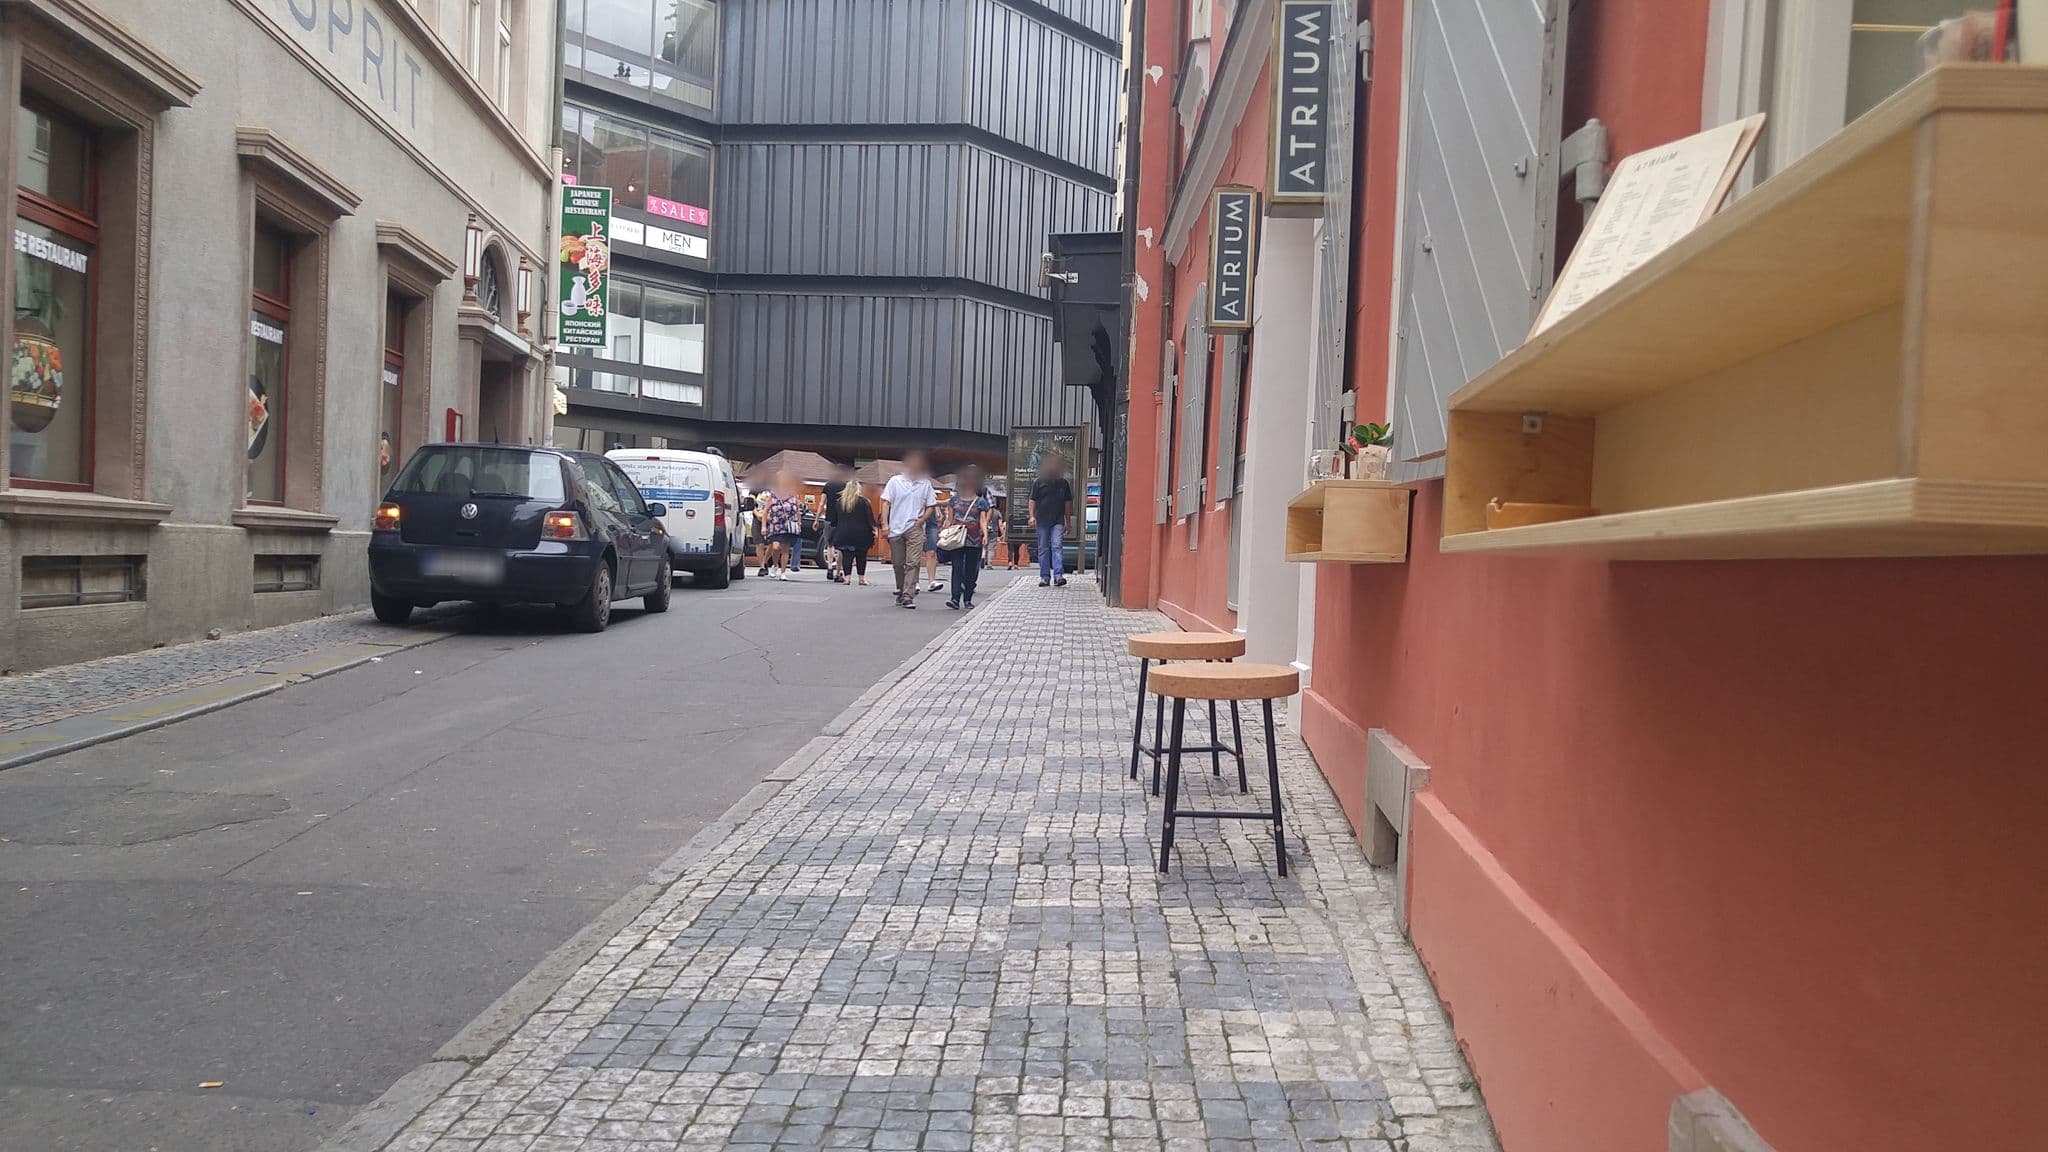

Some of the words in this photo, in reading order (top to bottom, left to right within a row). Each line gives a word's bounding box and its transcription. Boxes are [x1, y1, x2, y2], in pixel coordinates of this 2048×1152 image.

[1289, 10, 1322, 185] ATRIUM
[1632, 151, 1679, 174] ATRIUM
[570, 189, 603, 199] JAPANESE
[572, 198, 600, 207] CHINESE
[563, 206, 607, 217] RESTAURANT
[662, 231, 692, 249] MEN
[28, 234, 88, 274] RESTAURANT
[1221, 199, 1244, 317] ATRIUM
[562, 327, 603, 336] КИТАЙСКИЙ
[565, 335, 601, 344] РЕСТОРАН
